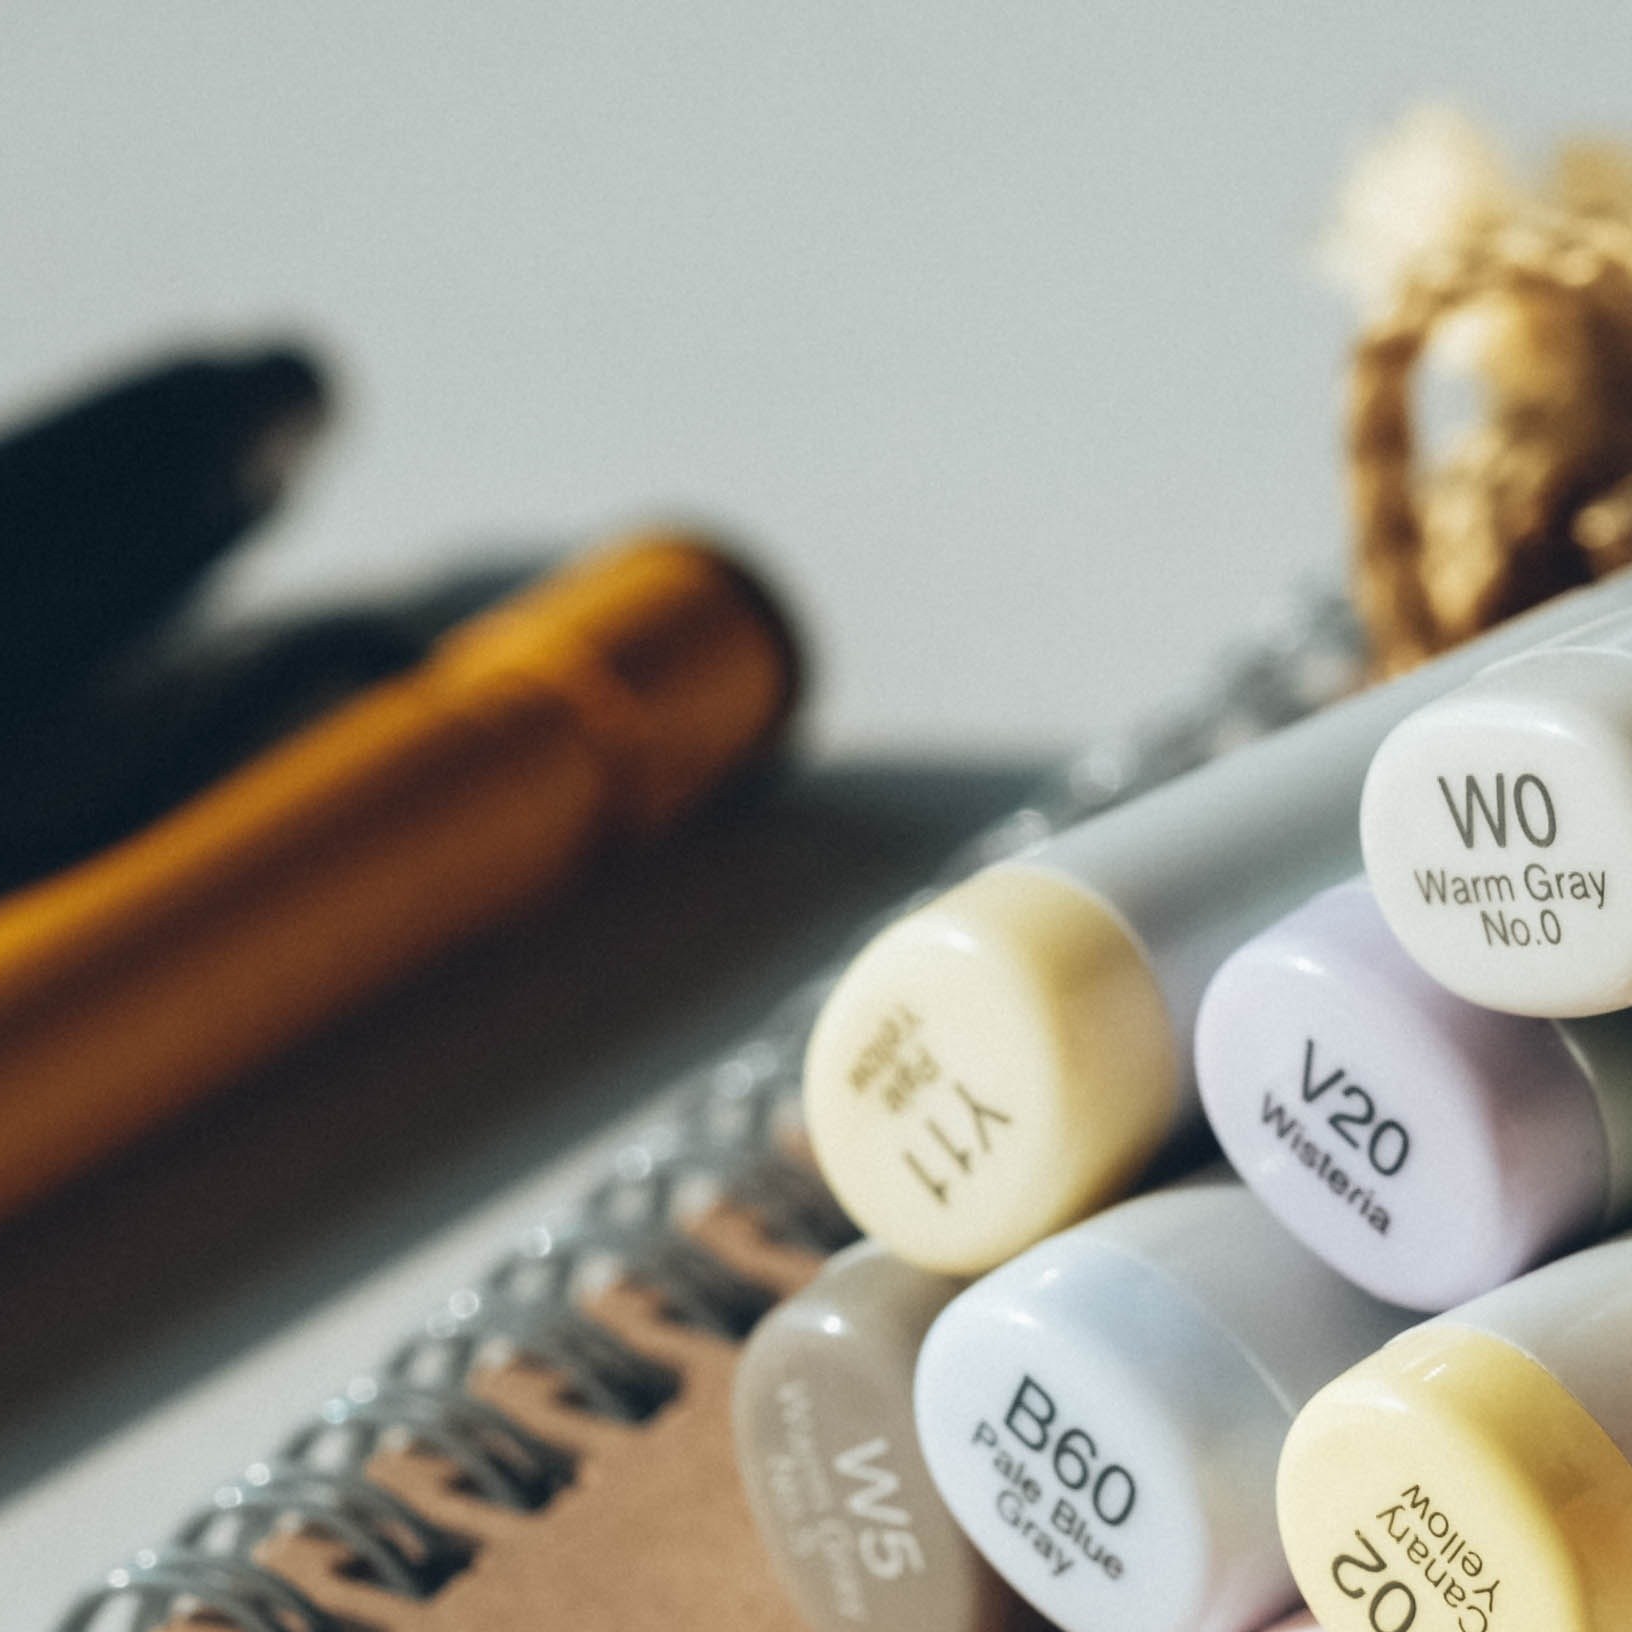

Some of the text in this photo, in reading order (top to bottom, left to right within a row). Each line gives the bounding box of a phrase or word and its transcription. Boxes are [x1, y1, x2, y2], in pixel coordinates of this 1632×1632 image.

[1438, 772, 1558, 850] W0
[1413, 865, 1609, 911] Warm Gray
[1481, 909, 1563, 948] No.0
[902, 1080, 1013, 1207] Y11
[1260, 1092, 1391, 1237] Wisteria
[1296, 1039, 1412, 1178] V20
[834, 1437, 925, 1580] W5
[971, 1420, 1125, 1581] Pale Blue
[1004, 1373, 1137, 1527] B60
[995, 1488, 1075, 1578] Gray
[1401, 1484, 1502, 1612] Yellow
